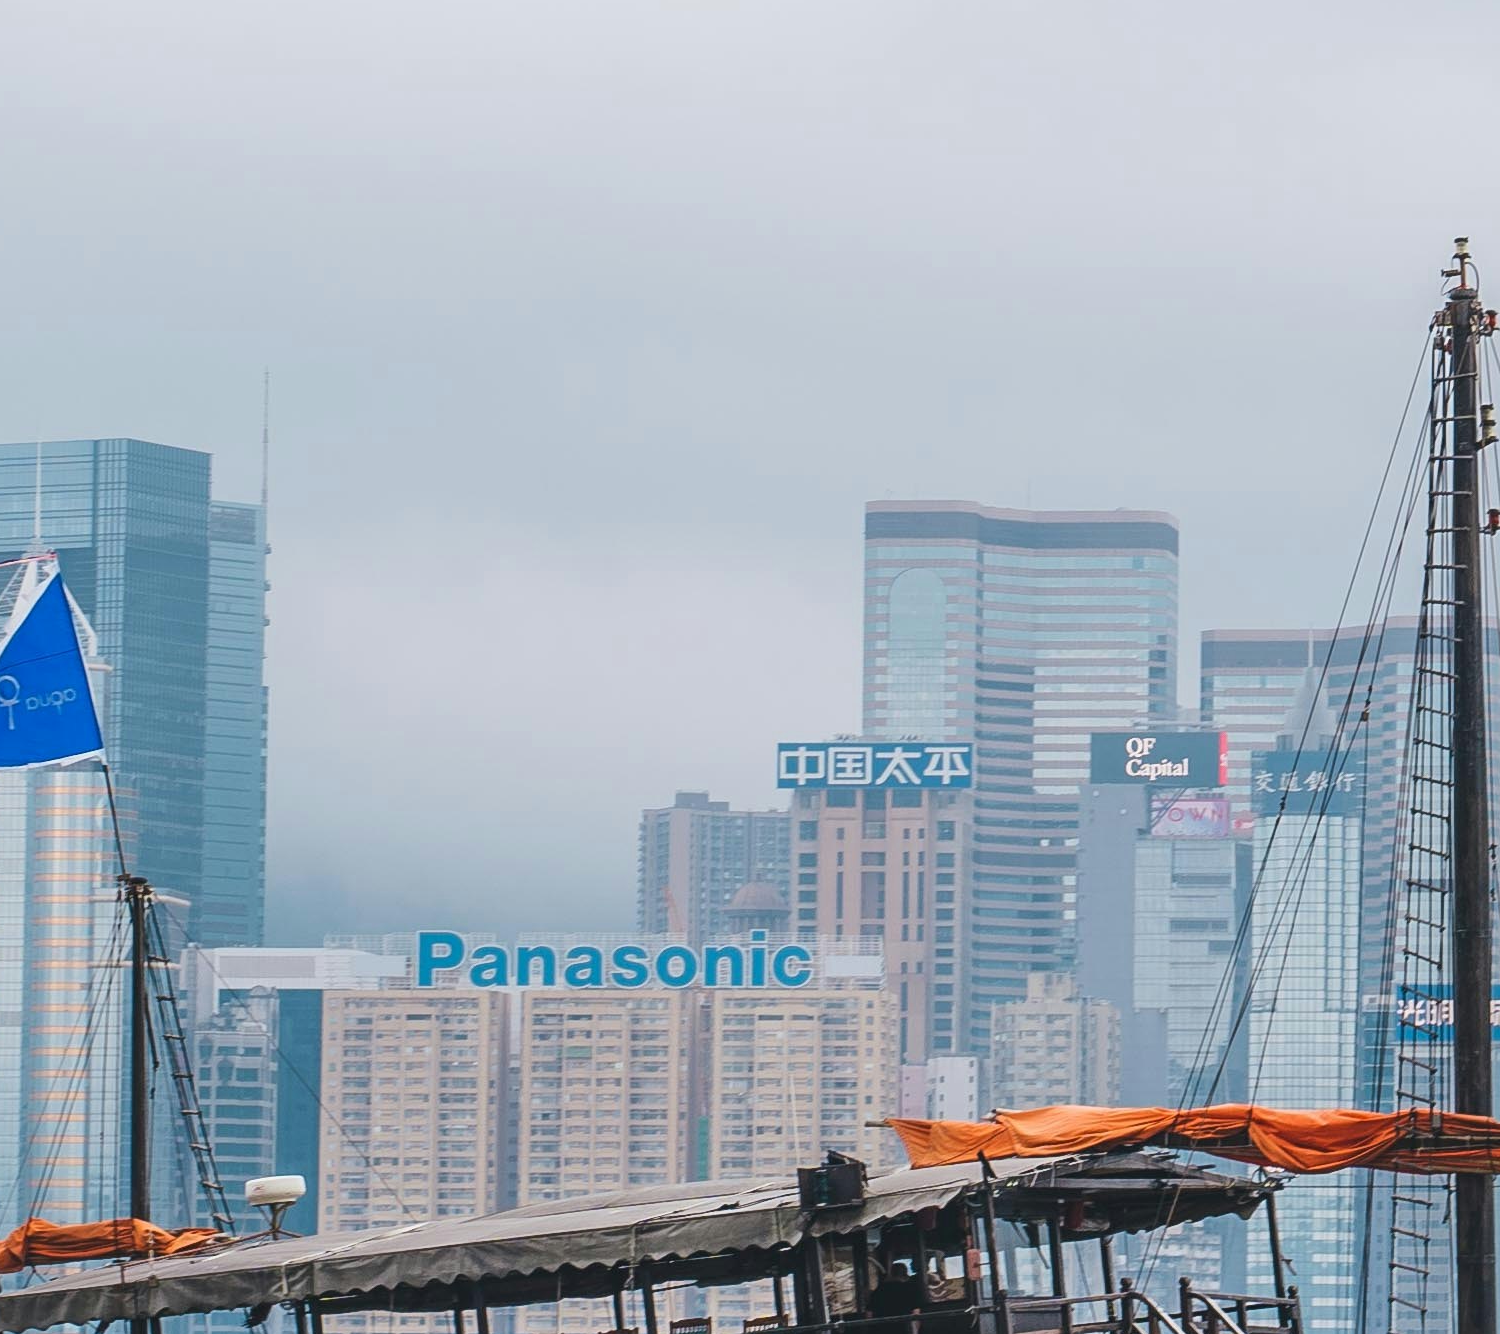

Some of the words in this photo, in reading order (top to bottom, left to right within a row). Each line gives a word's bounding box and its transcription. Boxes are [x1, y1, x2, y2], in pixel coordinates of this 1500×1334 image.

[1125, 737, 1157, 758] QF
[779, 746, 970, 785] 中国太平
[1125, 758, 1189, 781] Capital
[415, 929, 814, 989] Panasonic
